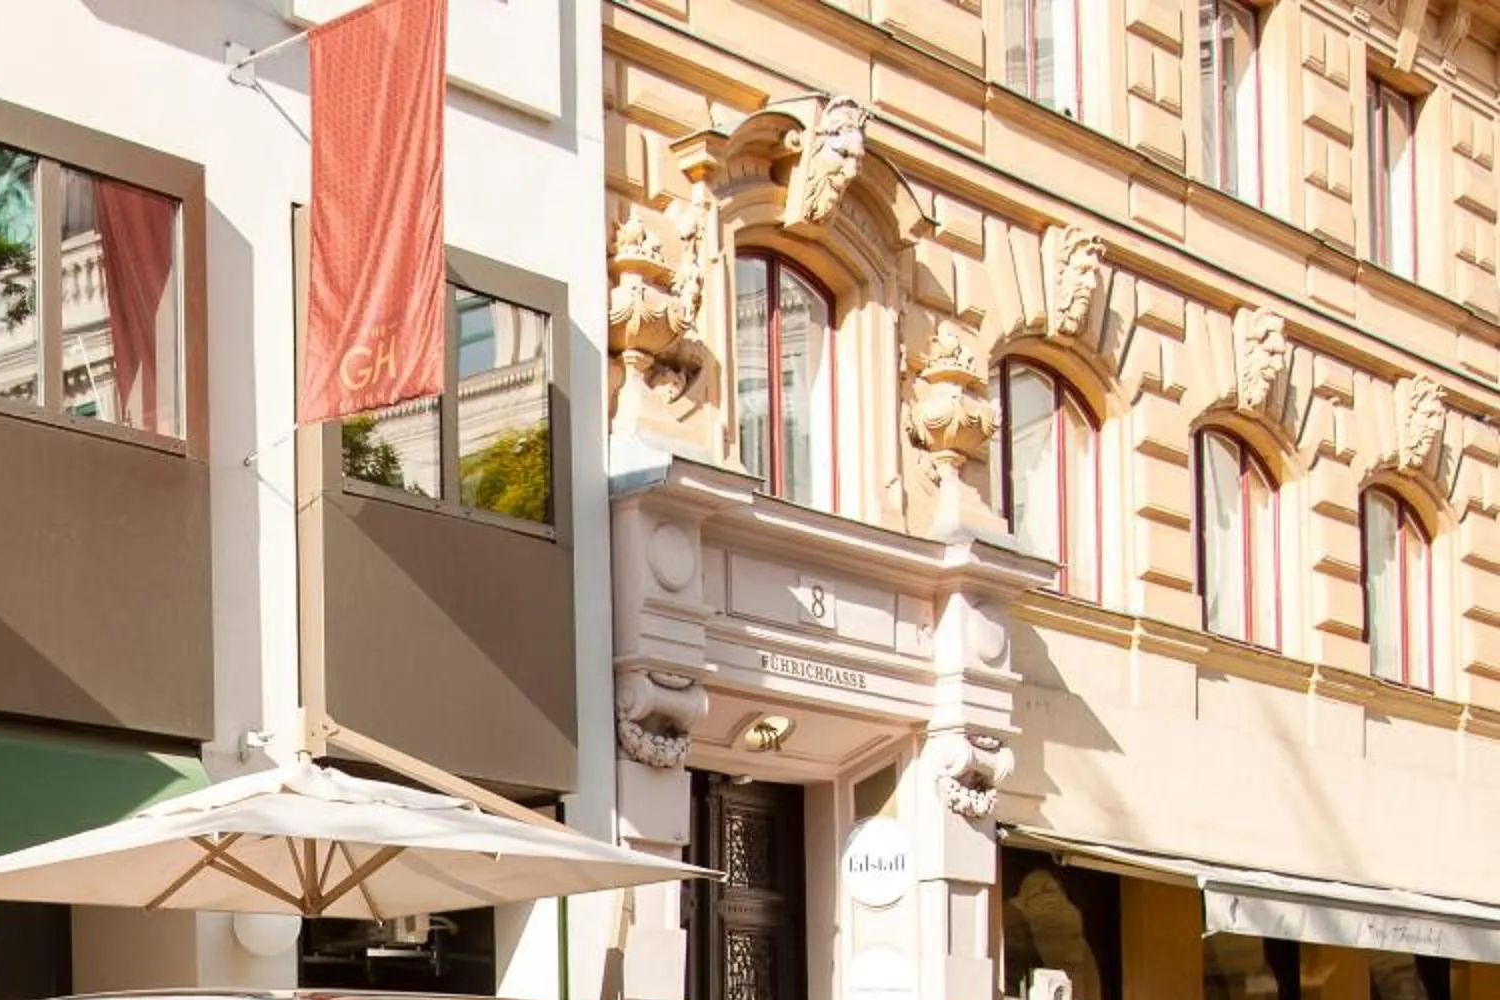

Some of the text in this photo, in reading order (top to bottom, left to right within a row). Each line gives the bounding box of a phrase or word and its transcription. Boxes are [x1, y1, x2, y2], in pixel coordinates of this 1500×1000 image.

[340, 335, 397, 391] GH
[812, 585, 825, 619] 8
[761, 653, 867, 688] FÜHRICHGASSE
